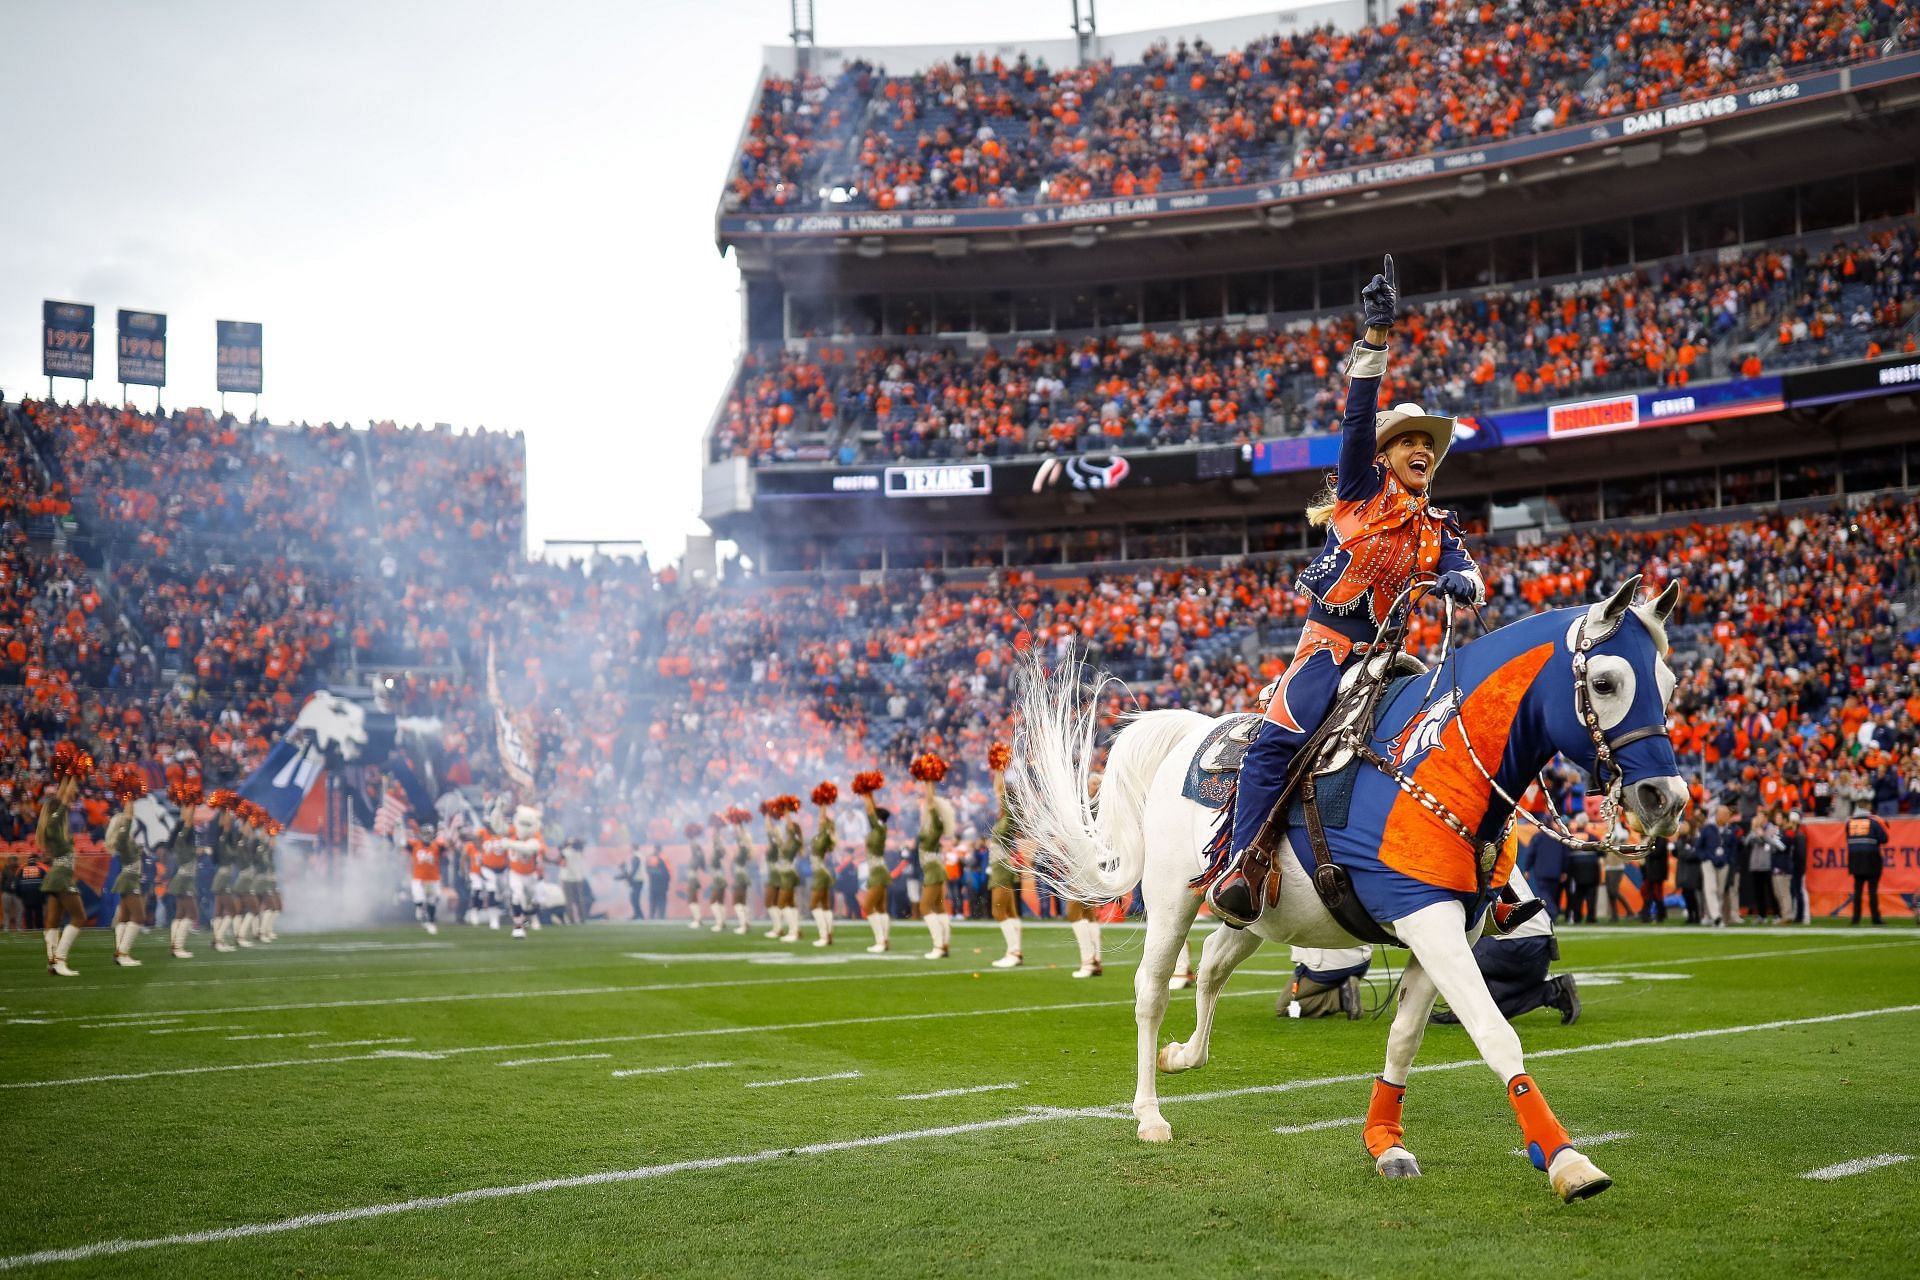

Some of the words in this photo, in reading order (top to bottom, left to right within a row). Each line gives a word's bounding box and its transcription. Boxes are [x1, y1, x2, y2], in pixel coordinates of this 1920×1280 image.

[1622, 111, 1663, 136] DAN
[1665, 95, 1738, 127] REEVES
[1279, 181, 1300, 198] 73
[1302, 172, 1353, 194] SIMON
[1356, 158, 1435, 184] FLETCHER
[1060, 202, 1112, 220] JASON
[1113, 198, 1158, 216] ELAM
[773, 217, 794, 231] 47
[798, 215, 843, 231] JOHN
[849, 214, 903, 230] LYNCH
[47, 328, 90, 350] 1997
[1554, 400, 1633, 432] BRONCOS
[1651, 396, 1696, 417] DENVER
[903, 468, 974, 491] TEXANS
[1812, 847, 1895, 869] SALE
[1900, 847, 1920, 868] T
